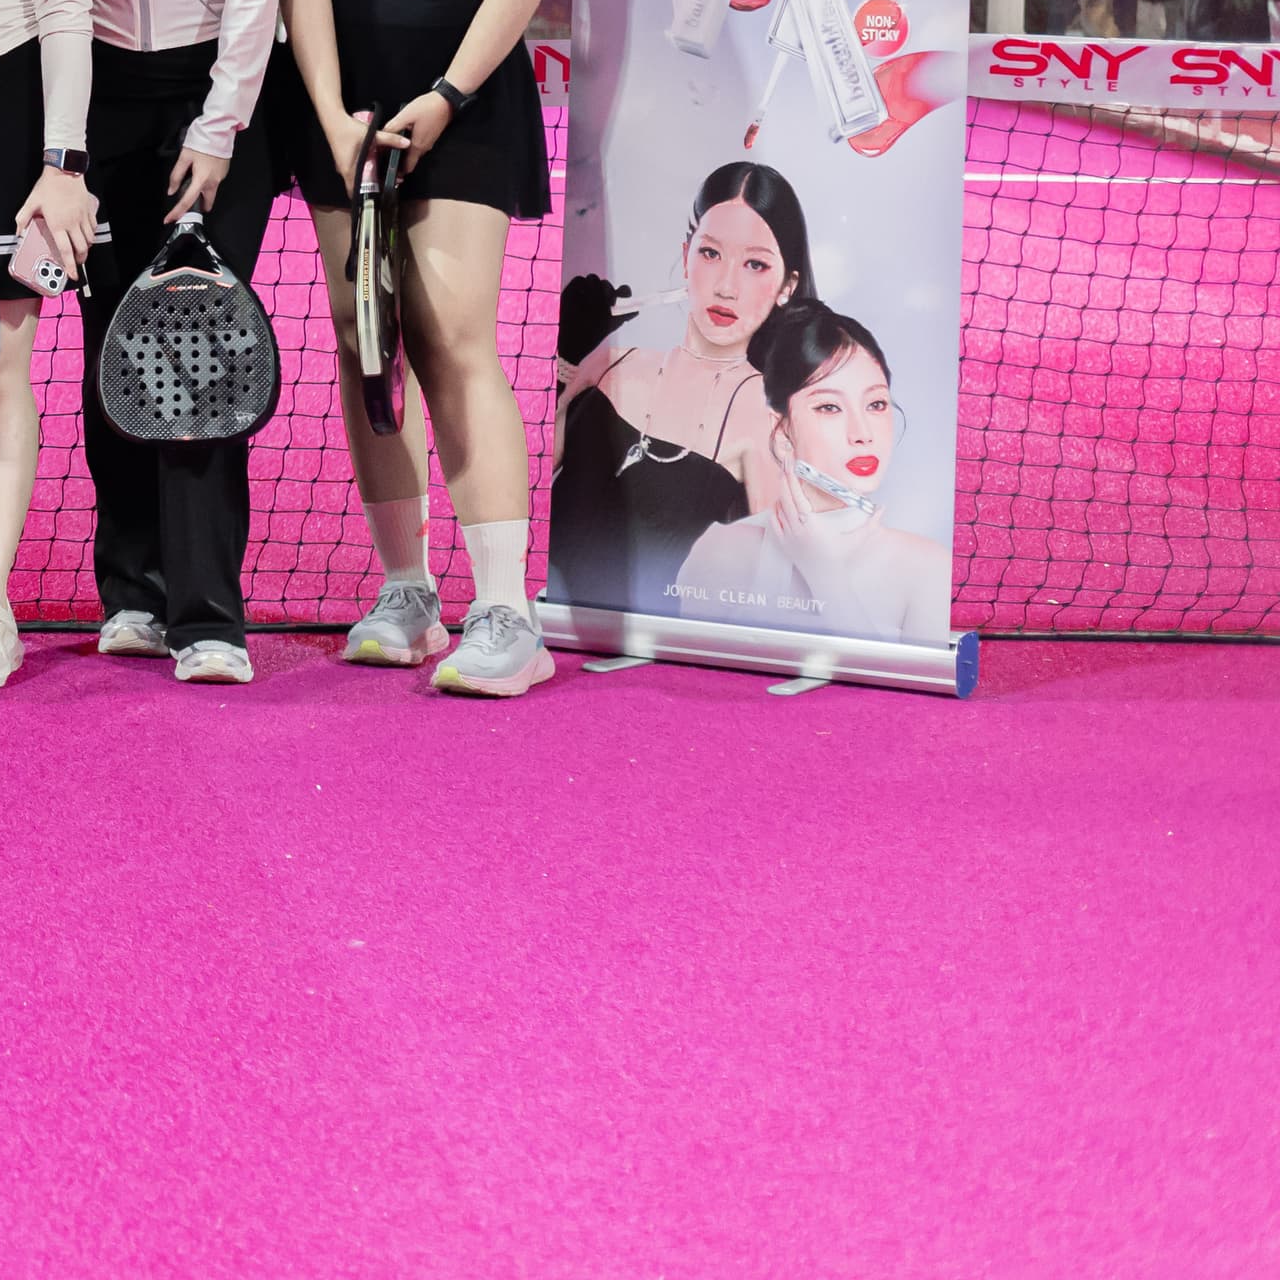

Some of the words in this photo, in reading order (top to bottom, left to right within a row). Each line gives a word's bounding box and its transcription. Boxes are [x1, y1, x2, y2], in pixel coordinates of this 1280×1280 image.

[865, 15, 896, 28] NON-
[861, 28, 900, 41] STICKY
[989, 38, 1151, 82] SNY
[1169, 47, 1280, 87] SN
[1013, 76, 1119, 93] STYLE
[1192, 84, 1278, 98] STYL
[662, 583, 710, 601] JOYFUL
[719, 589, 768, 608] CLEAN
[776, 595, 826, 612] BEAUTY
